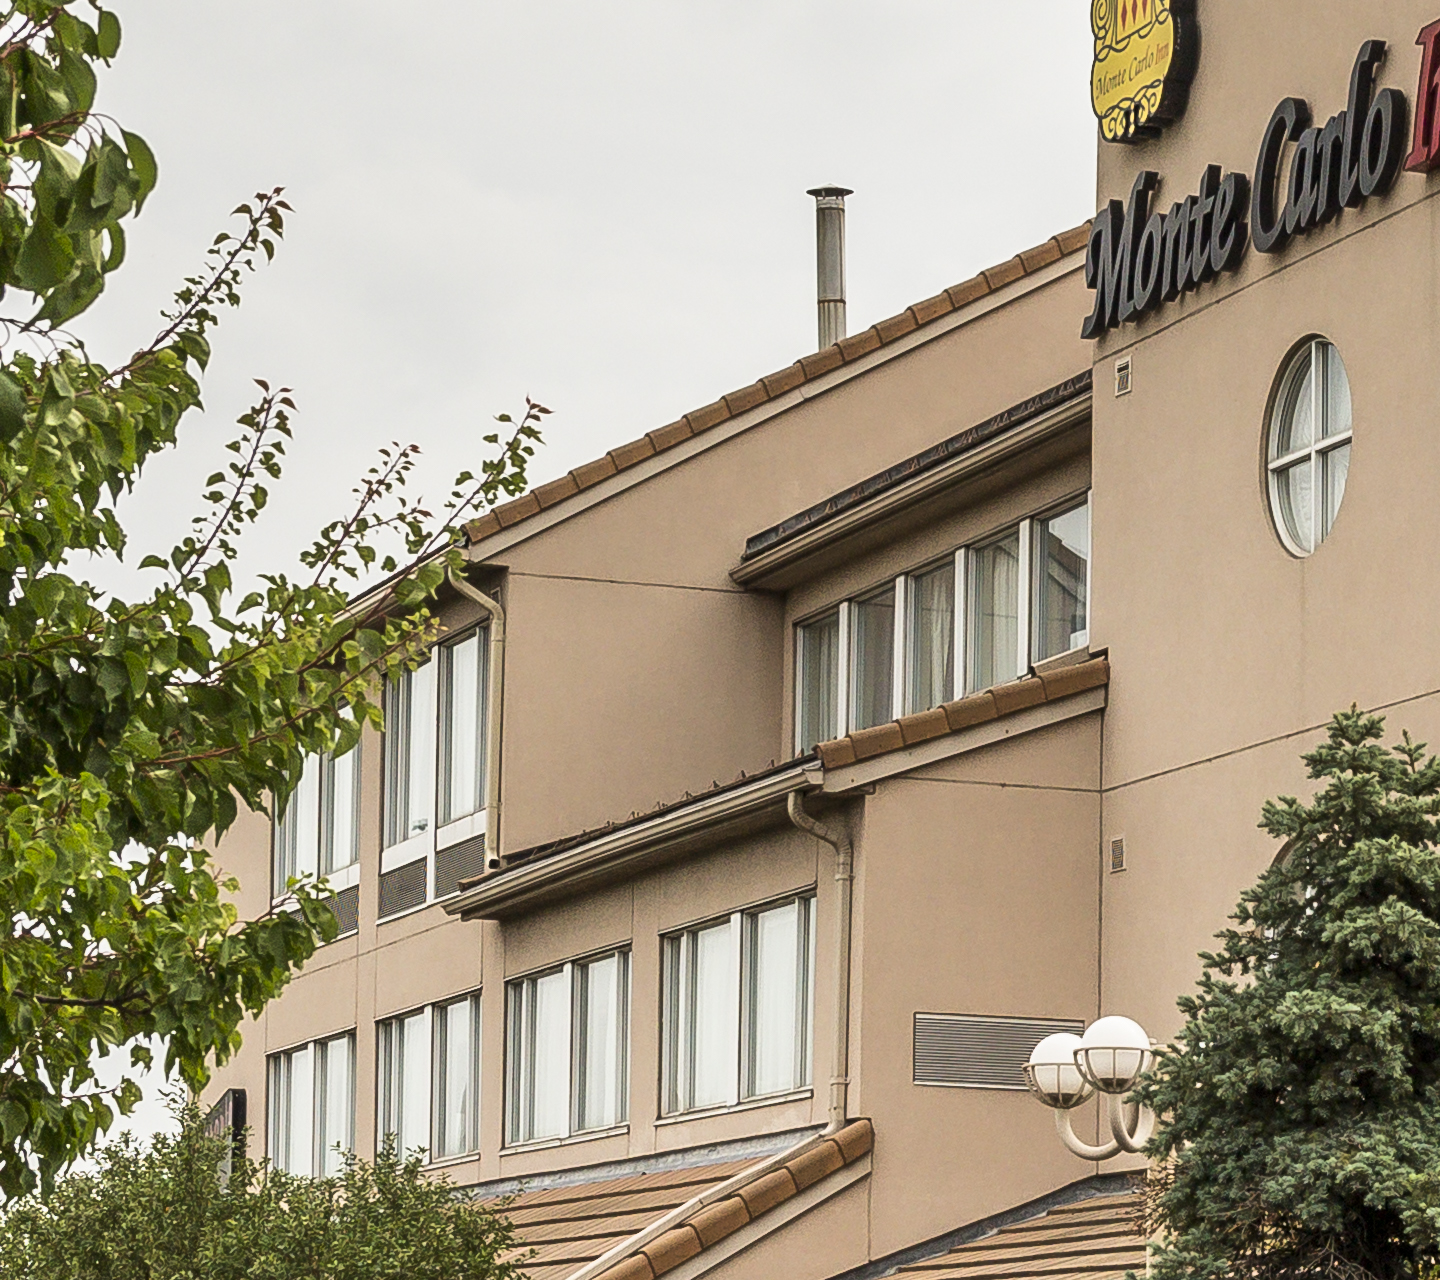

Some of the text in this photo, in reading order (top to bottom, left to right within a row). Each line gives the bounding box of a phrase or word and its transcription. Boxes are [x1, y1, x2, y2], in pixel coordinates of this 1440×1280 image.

[1095, 42, 1169, 100] Monte Carlo Inn
[1080, 163, 1250, 340] Monte
[1251, 39, 1407, 253] Carlo
